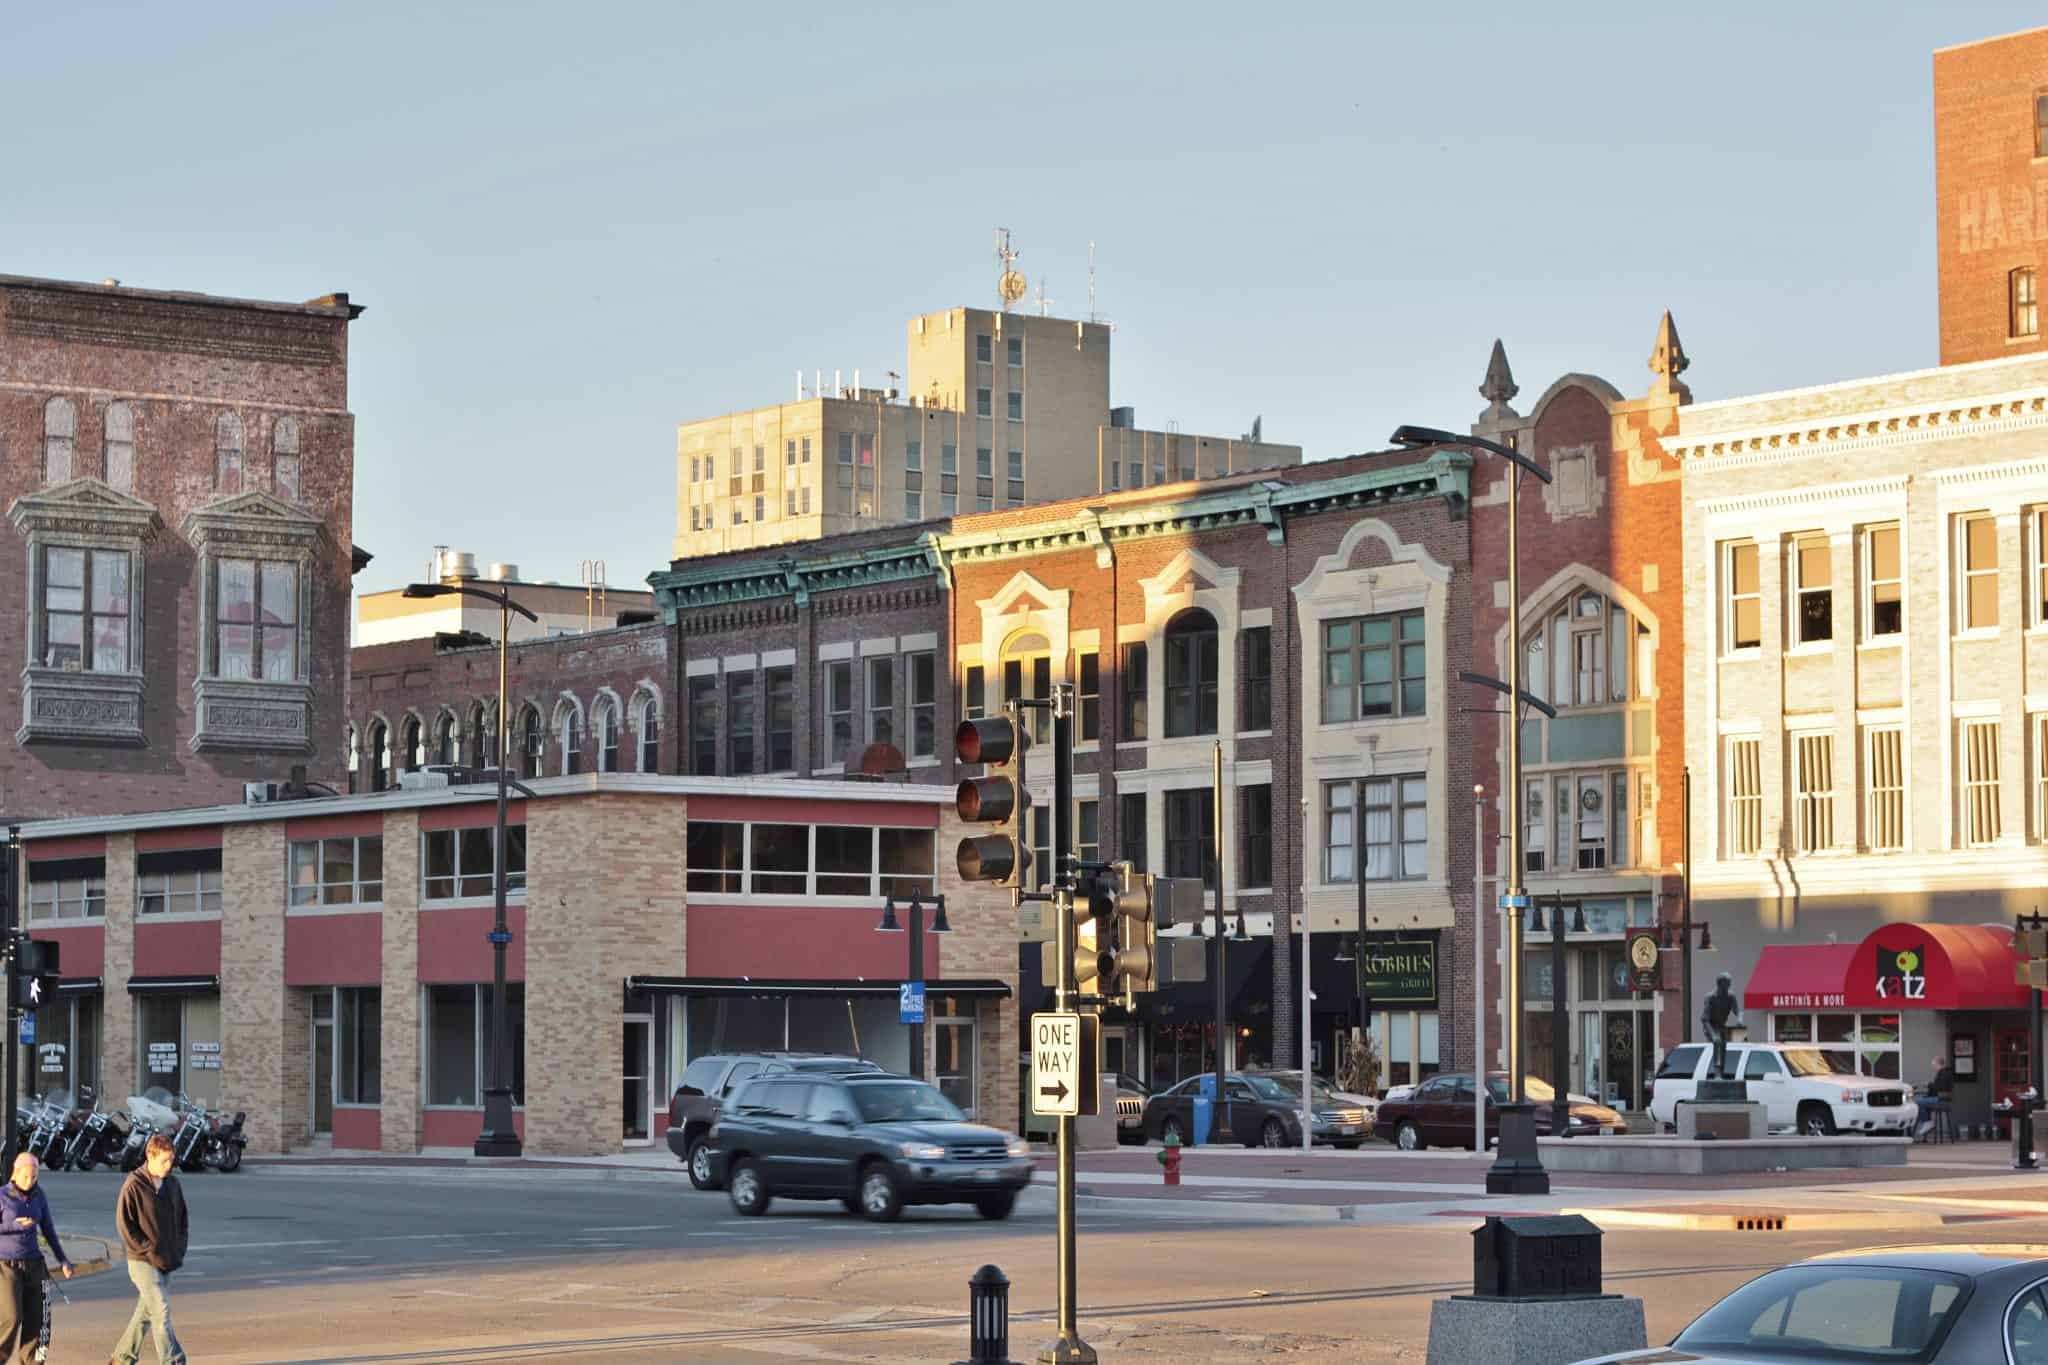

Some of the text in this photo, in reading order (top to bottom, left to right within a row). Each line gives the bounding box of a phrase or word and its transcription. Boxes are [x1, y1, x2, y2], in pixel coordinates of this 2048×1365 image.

[1823, 993, 1845, 1007] MORE
[1039, 1023, 1072, 1046] ONE
[1039, 1050, 1073, 1073] WAY
